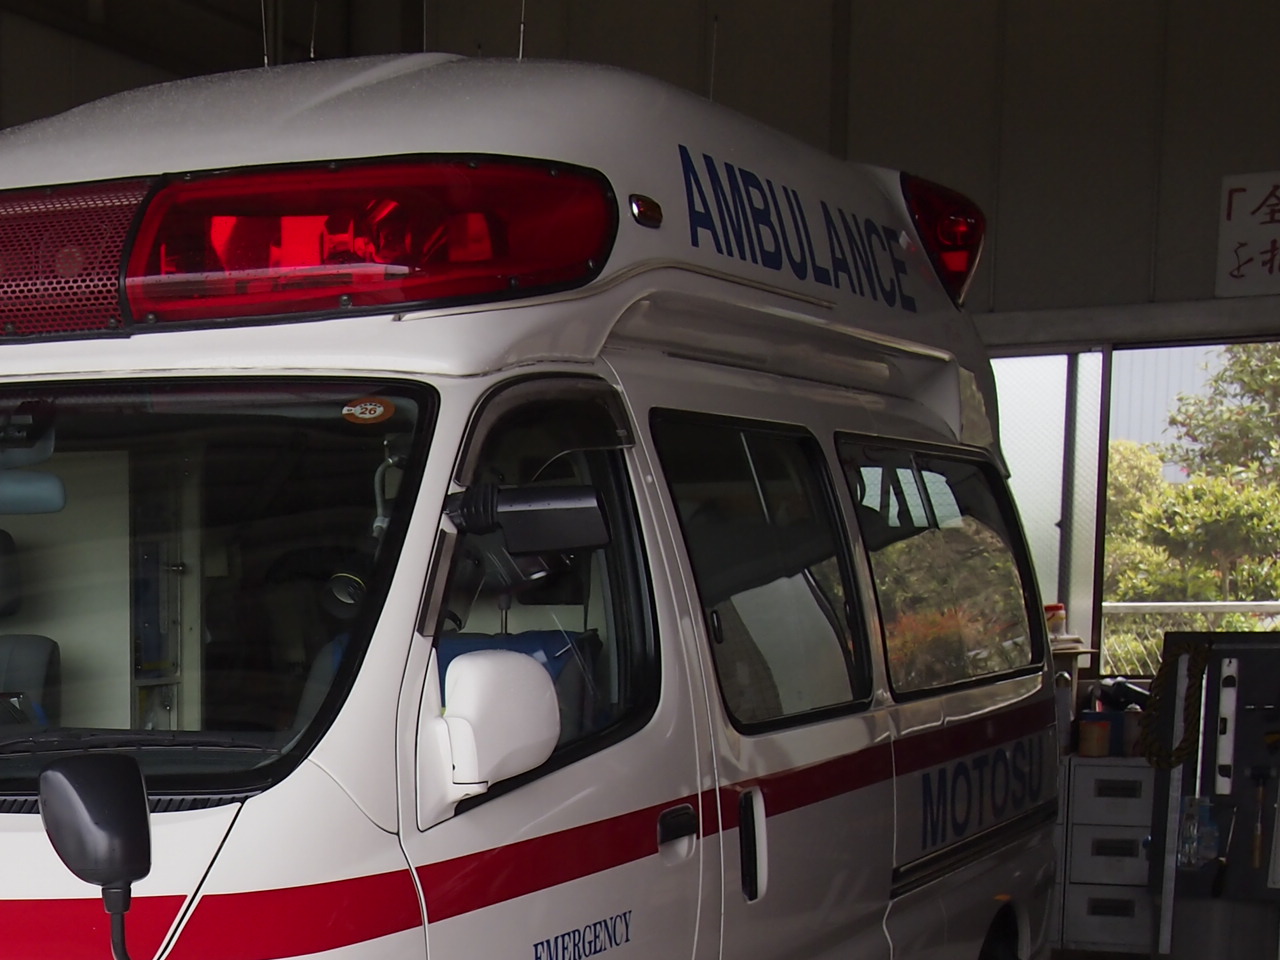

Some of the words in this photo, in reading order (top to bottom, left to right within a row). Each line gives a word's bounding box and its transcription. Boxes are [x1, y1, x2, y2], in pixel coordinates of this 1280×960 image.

[678, 144, 917, 313] AMBULANCE
[359, 406, 378, 415] 26
[921, 735, 1043, 851] MOTOSU
